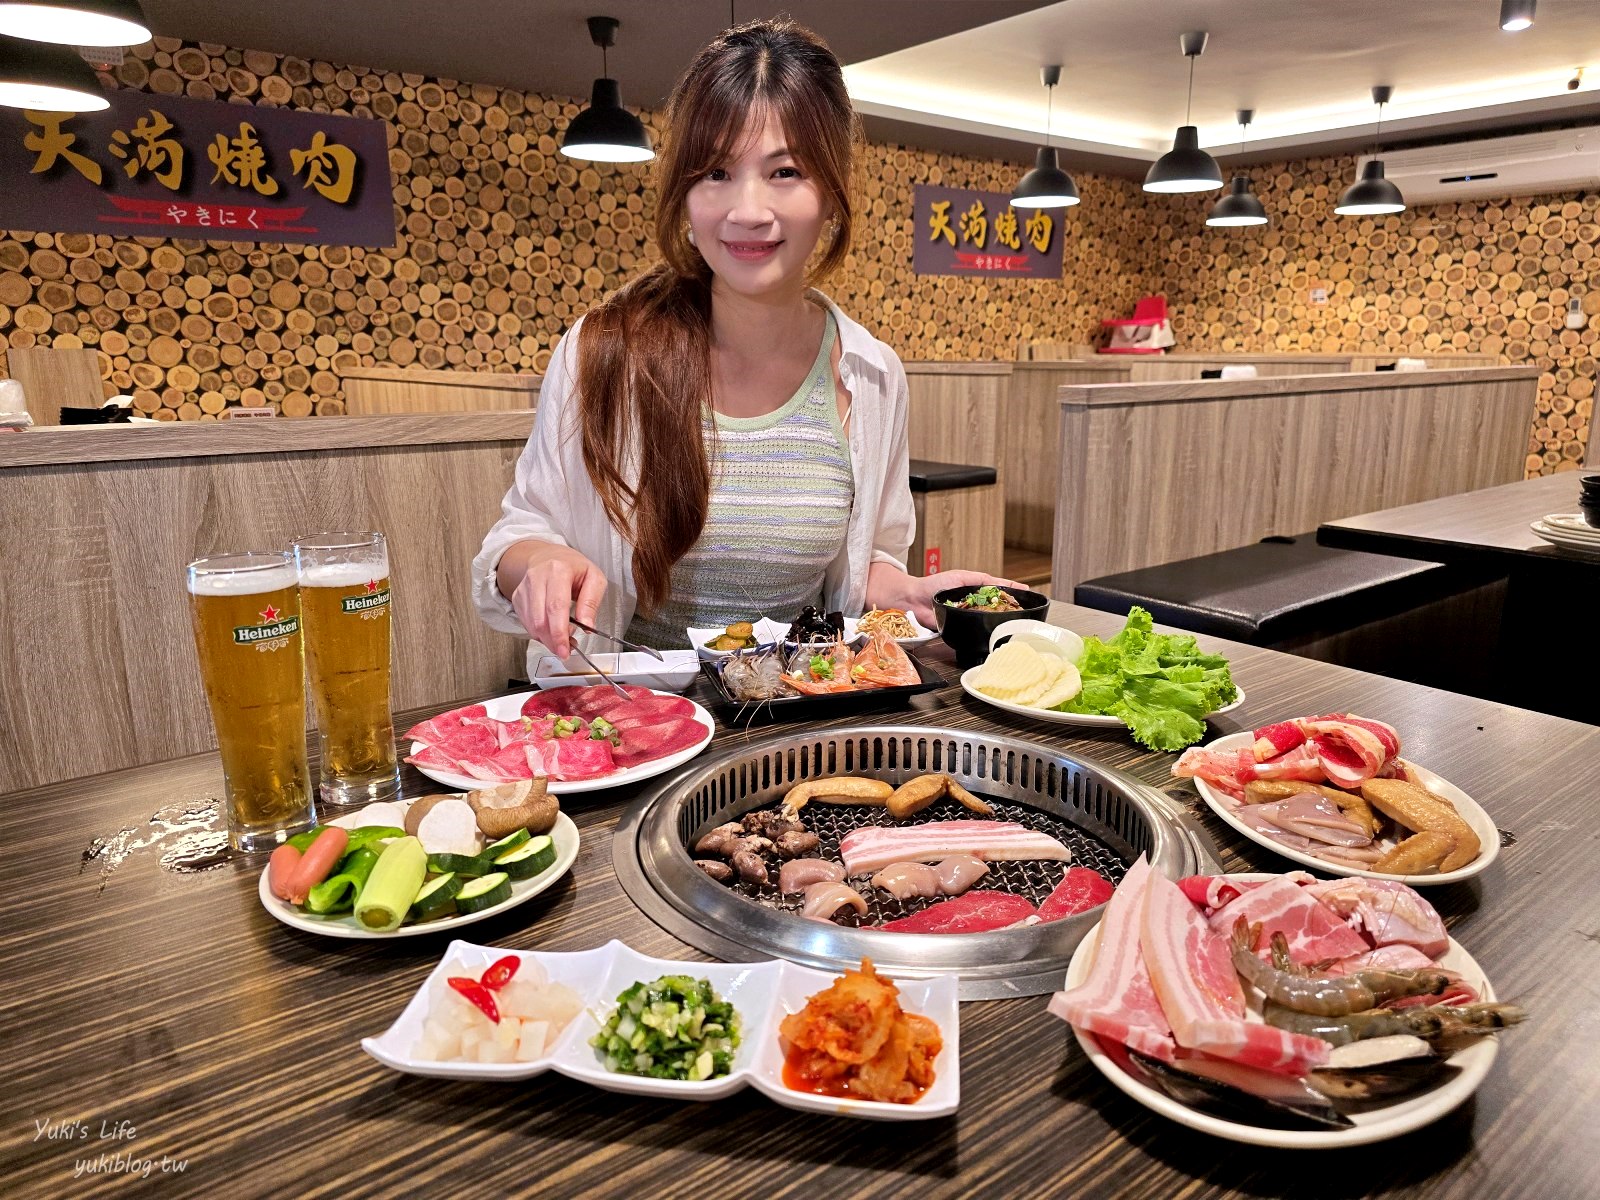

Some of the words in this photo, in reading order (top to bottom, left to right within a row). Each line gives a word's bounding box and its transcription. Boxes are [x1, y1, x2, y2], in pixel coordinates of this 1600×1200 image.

[166, 205, 261, 229] やきにく
[975, 256, 1012, 271] やきにく
[238, 618, 298, 642] Heineken
